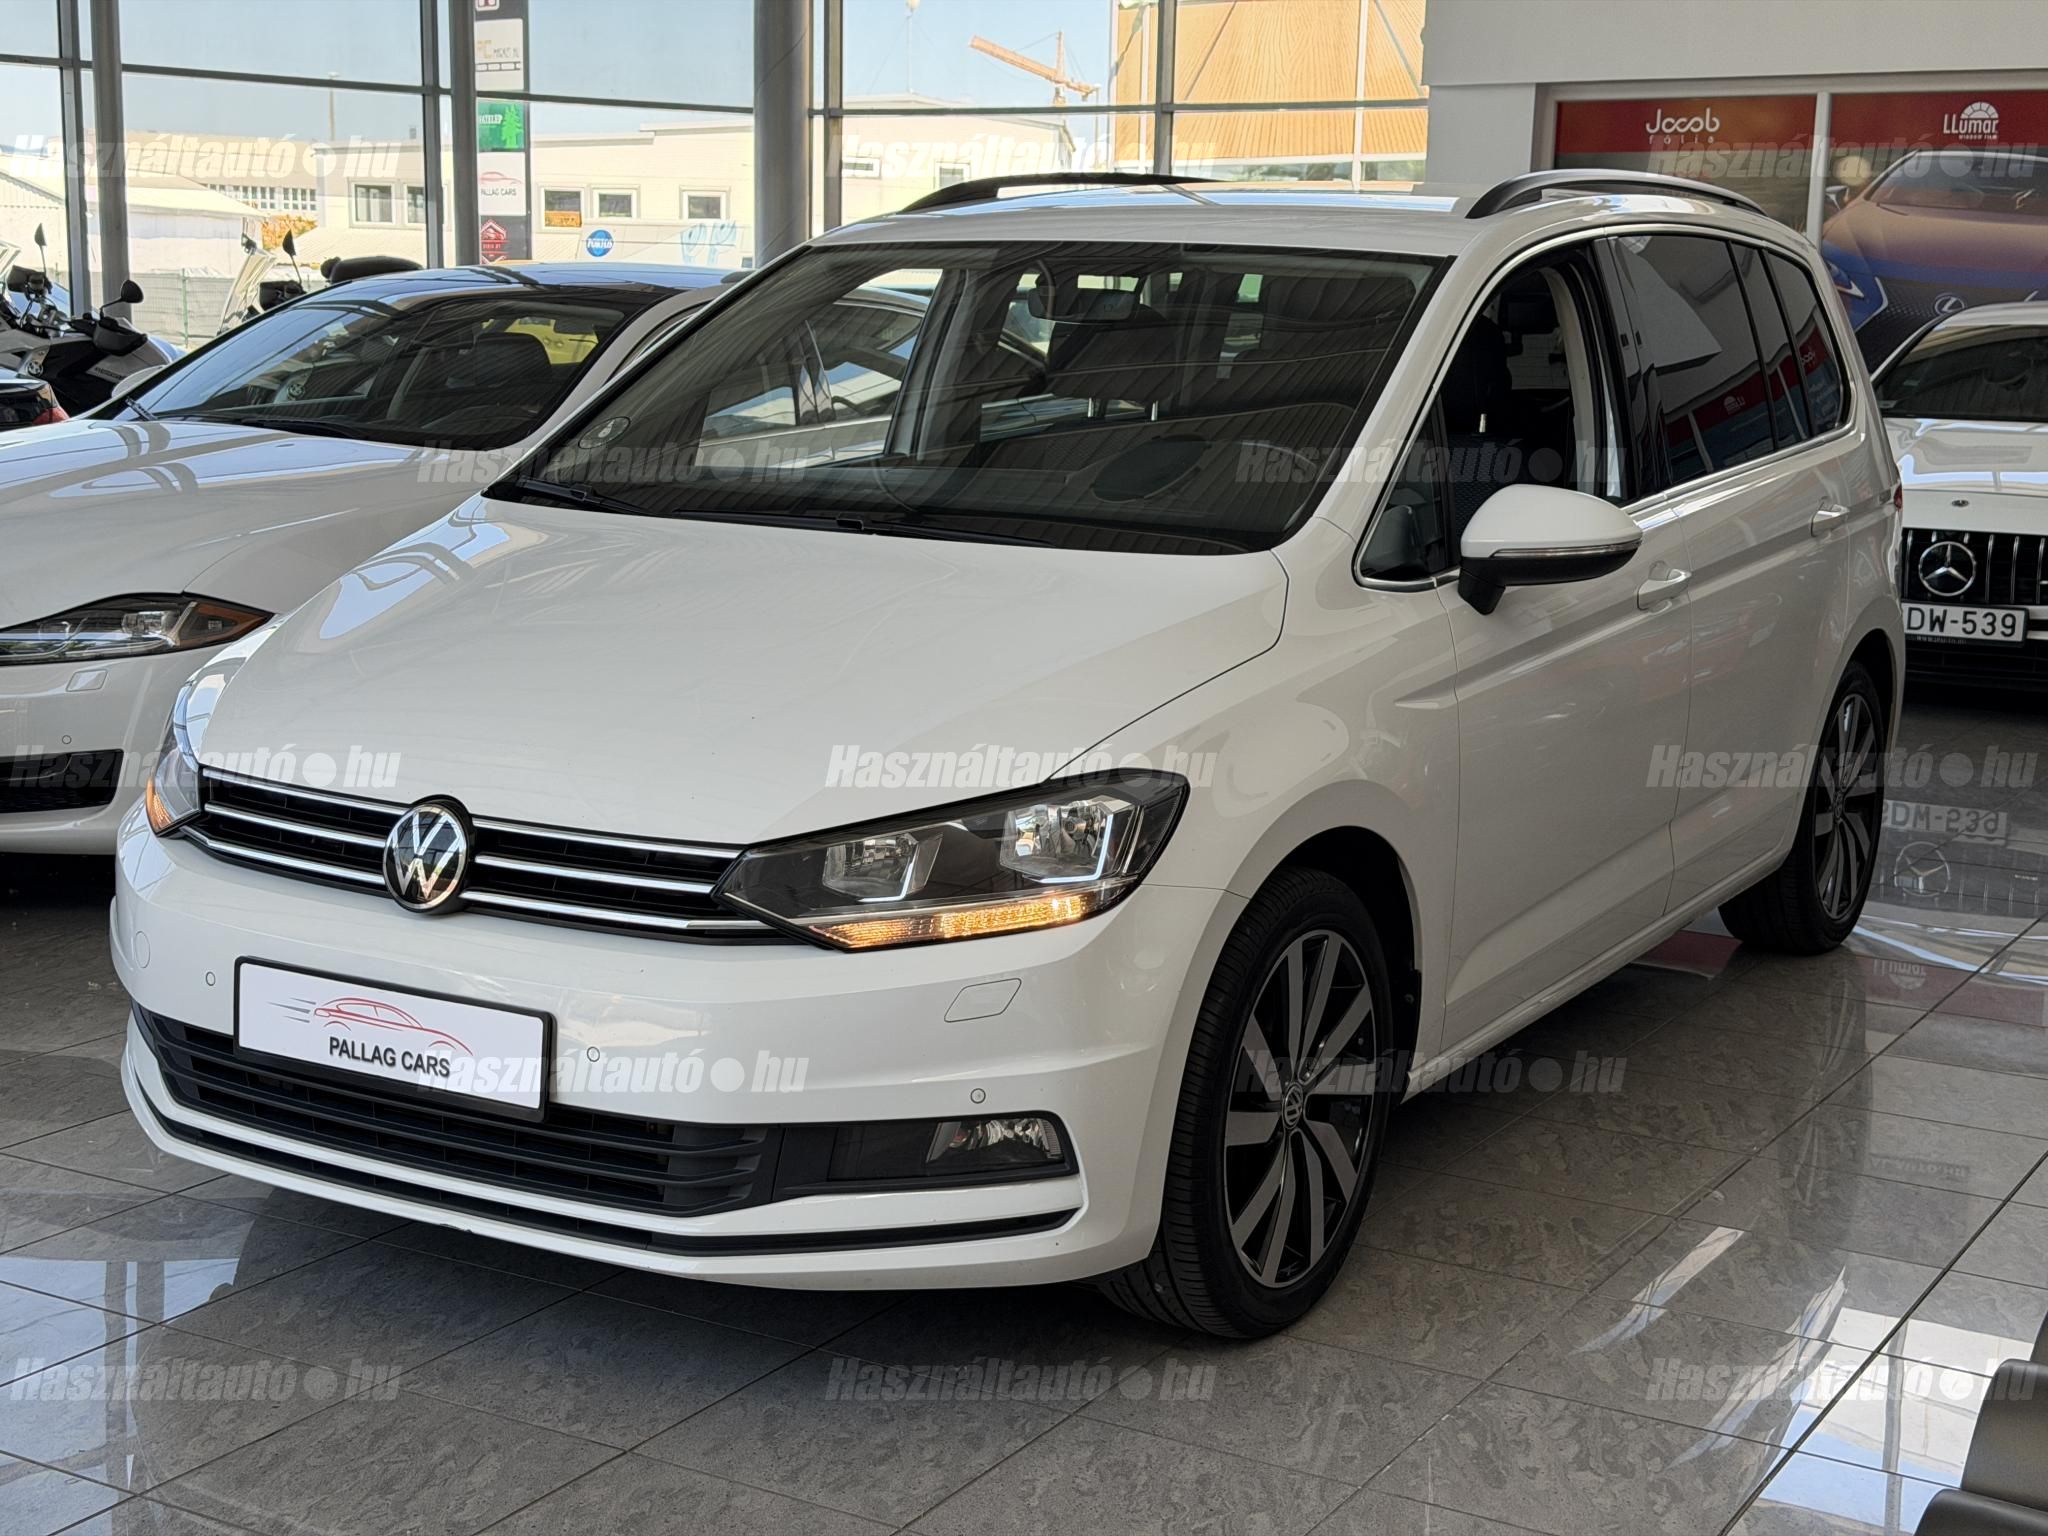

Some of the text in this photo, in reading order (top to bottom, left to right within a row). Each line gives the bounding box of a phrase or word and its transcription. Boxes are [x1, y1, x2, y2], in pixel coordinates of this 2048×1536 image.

[1943, 113, 1999, 134] LLumar
[1906, 606, 2017, 638] DW-539
[329, 1036, 451, 1078] PALLAG CARS
